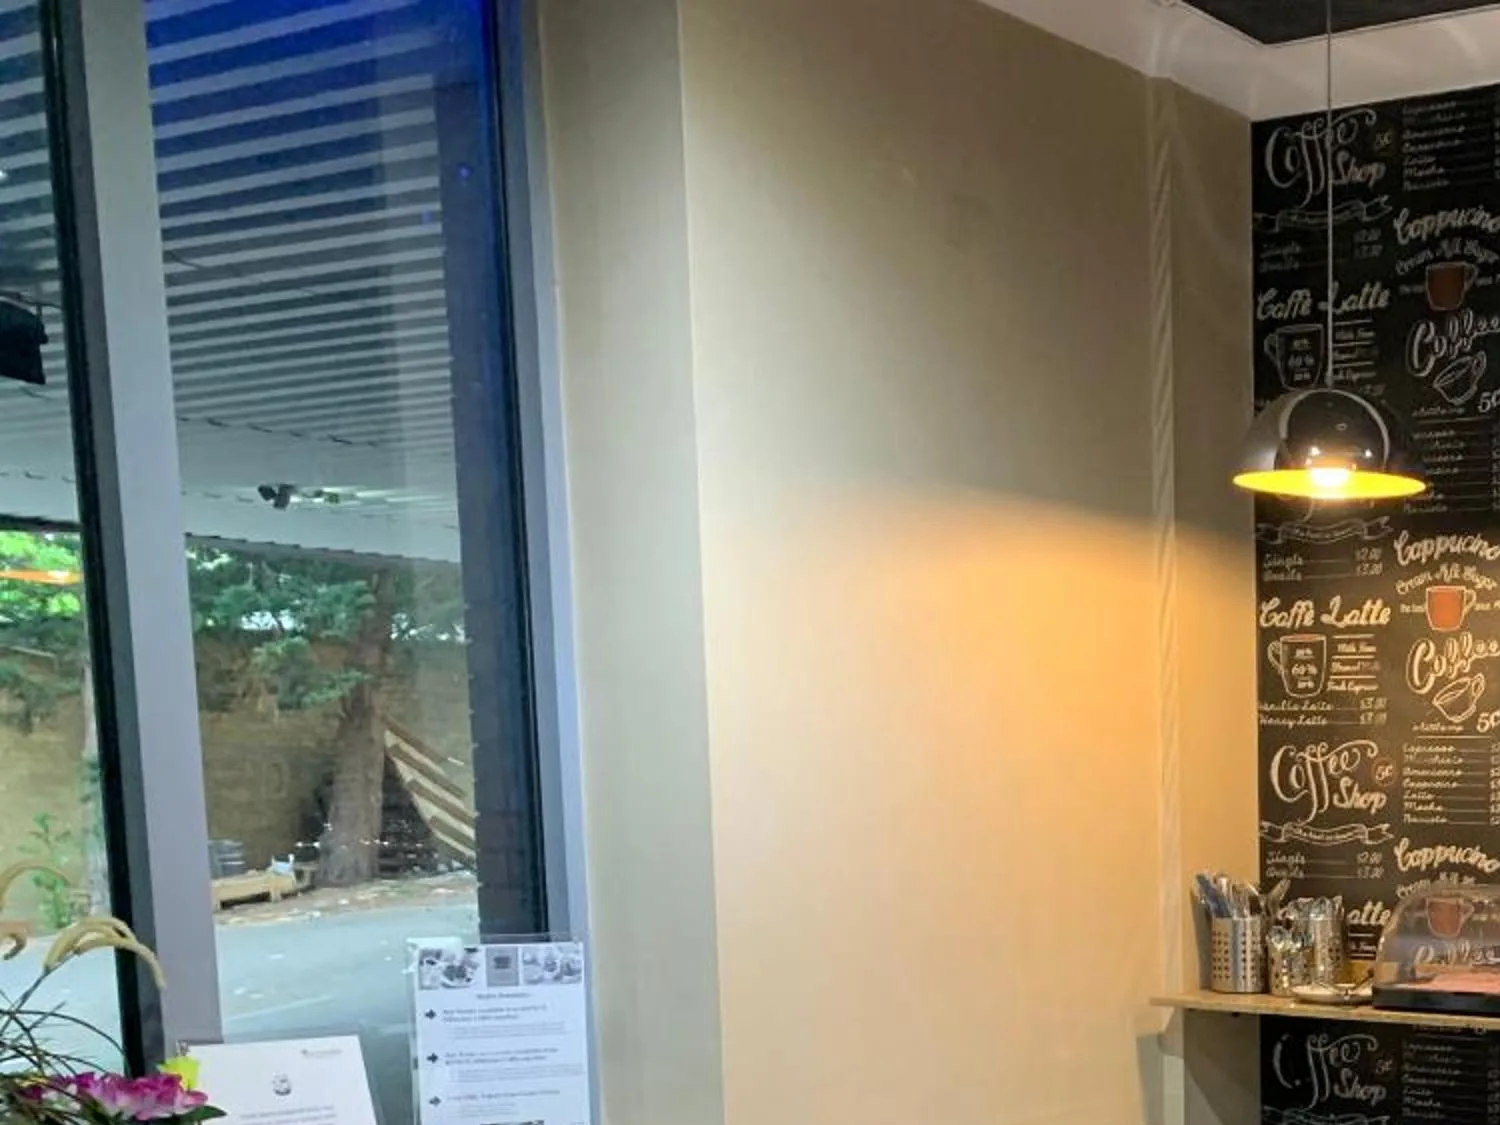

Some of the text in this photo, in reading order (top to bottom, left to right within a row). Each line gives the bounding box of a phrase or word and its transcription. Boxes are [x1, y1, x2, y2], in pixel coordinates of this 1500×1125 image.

[1320, 595, 1390, 627] Latte
[1270, 740, 1379, 826] Coffee
[1332, 775, 1387, 815] Shop
